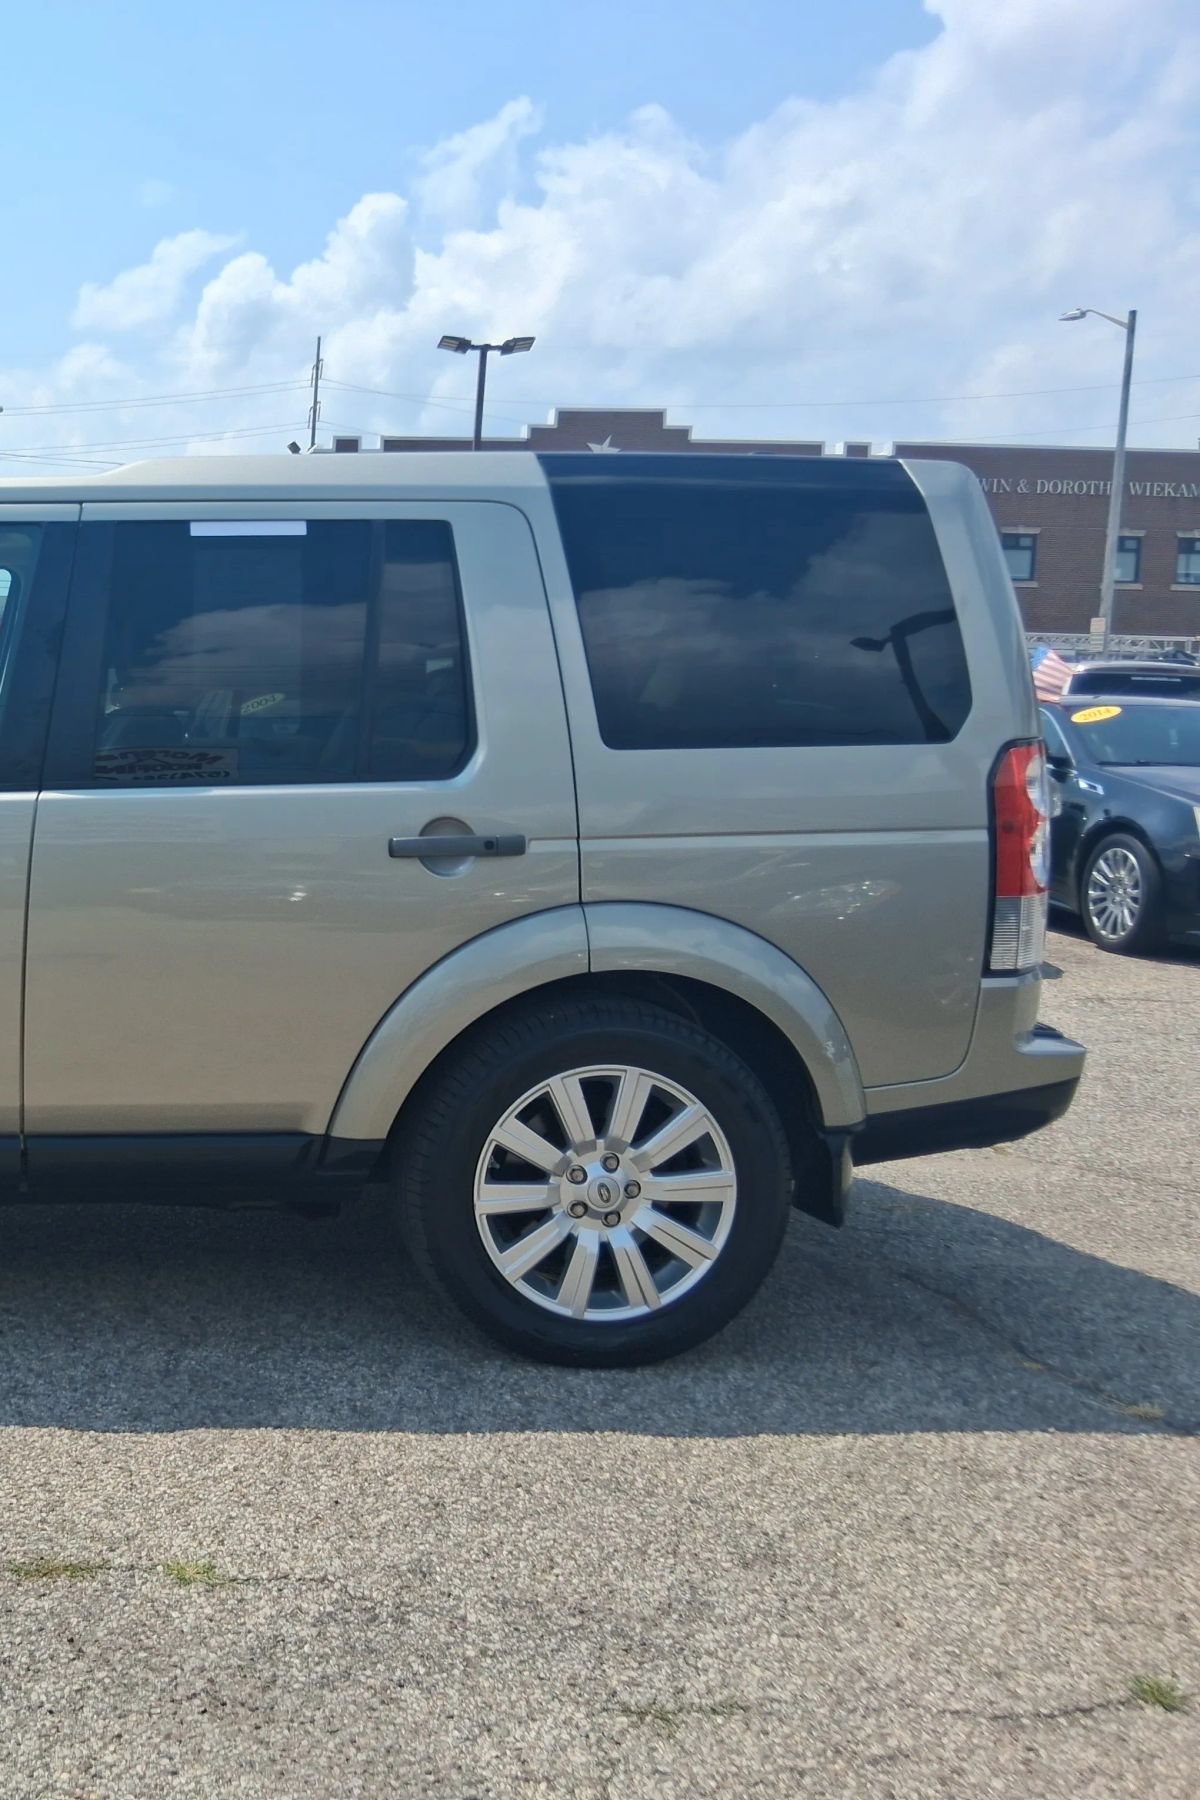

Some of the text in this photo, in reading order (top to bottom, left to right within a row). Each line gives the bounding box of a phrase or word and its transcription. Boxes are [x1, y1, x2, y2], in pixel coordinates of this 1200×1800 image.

[1016, 478, 1030, 494] &
[1036, 479, 1114, 495] DOROTH
[1079, 708, 1117, 721] 2014
